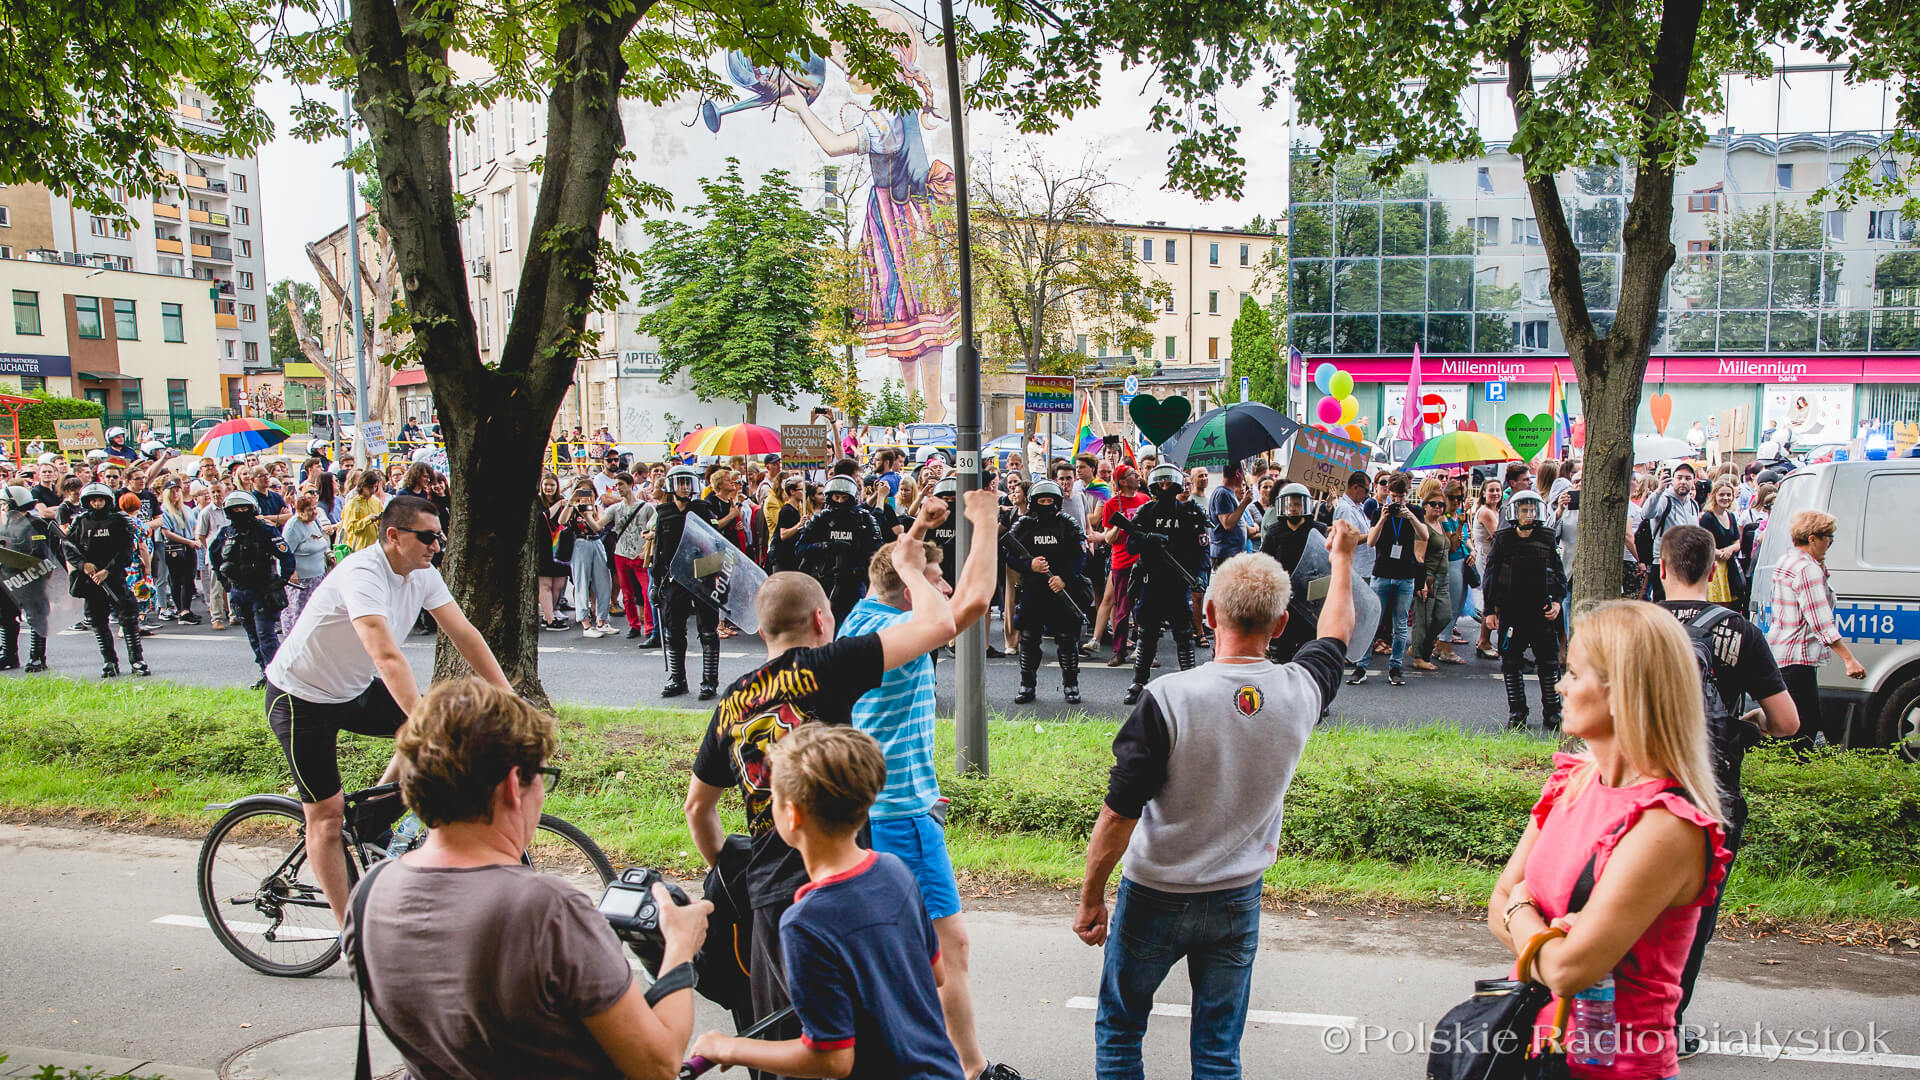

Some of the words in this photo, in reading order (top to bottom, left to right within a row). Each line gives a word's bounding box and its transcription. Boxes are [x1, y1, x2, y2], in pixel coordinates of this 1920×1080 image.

[0, 363, 39, 373] UCHALTER
[1441, 359, 1525, 374] Millennium
[1719, 359, 1807, 374] Millennium
[1498, 374, 1517, 382] bank
[782, 427, 825, 437] WSZYSTKIE
[785, 438, 824, 447] RODZINY
[1295, 427, 1370, 473] SISTERS
[959, 457, 973, 468] 30
[1317, 462, 1334, 474] NOT
[830, 530, 853, 540] POLICJA
[1034, 535, 1058, 545] POLICJA
[3, 558, 57, 591] POLICJA
[710, 546, 735, 604] POLICJA
